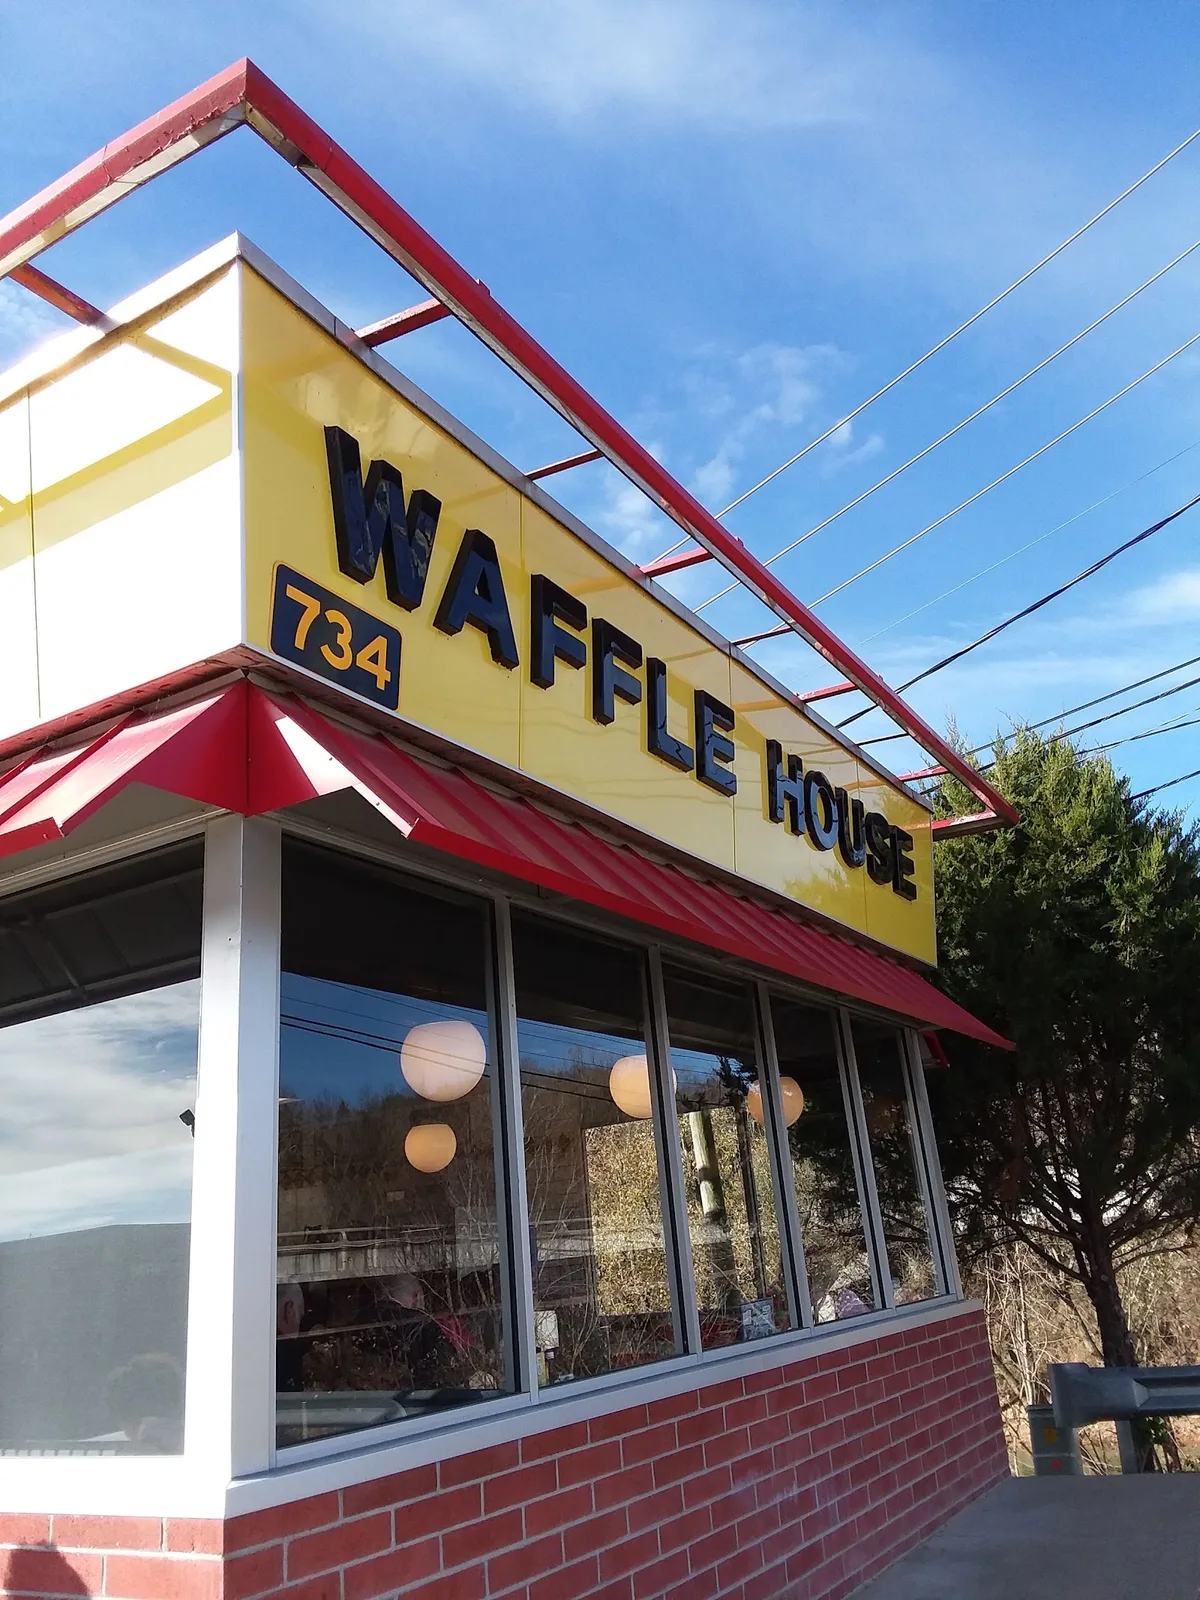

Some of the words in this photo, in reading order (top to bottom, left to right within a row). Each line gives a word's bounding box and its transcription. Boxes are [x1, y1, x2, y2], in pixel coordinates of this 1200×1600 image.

[285, 584, 391, 690] 734
[323, 425, 737, 798] WAFFLE
[767, 739, 917, 901] HOUSE
